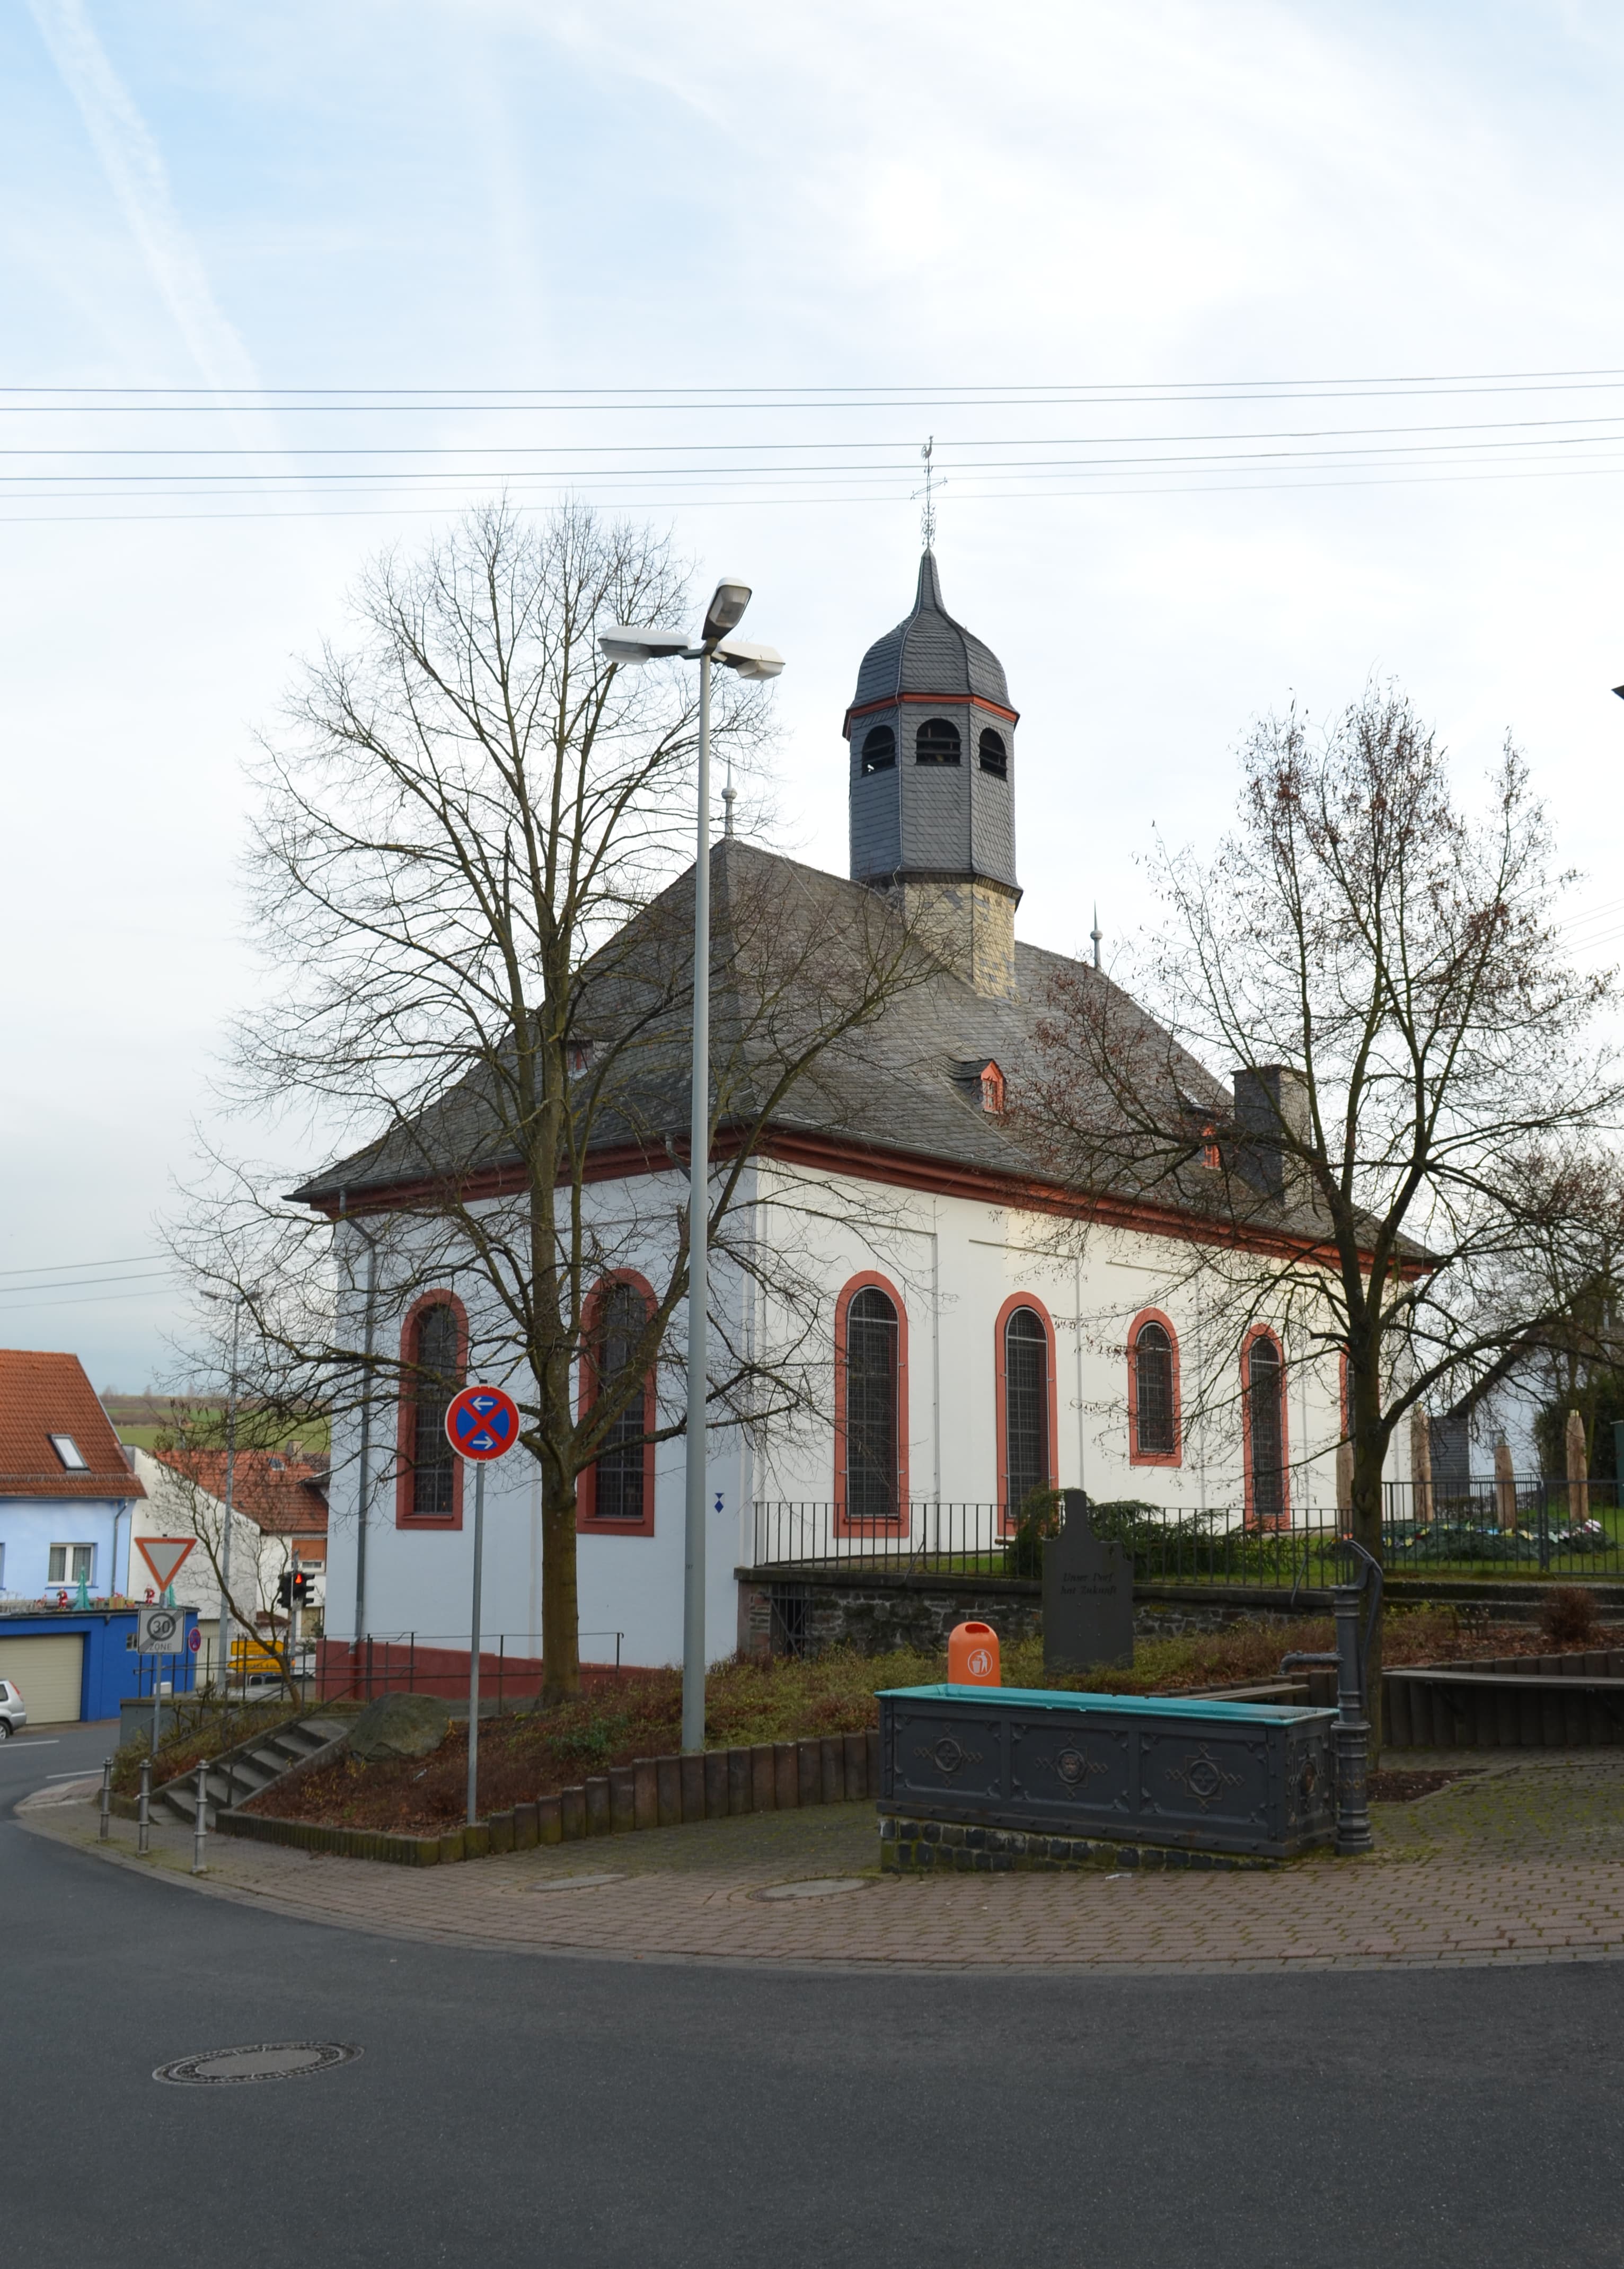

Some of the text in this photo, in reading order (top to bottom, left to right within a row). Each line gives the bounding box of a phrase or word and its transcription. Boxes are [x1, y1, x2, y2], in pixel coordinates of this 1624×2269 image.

[1063, 1572, 1115, 1583] Unser Dorf
[1061, 1585, 1117, 1596] hat Zukunft
[153, 1620, 170, 1633] 30
